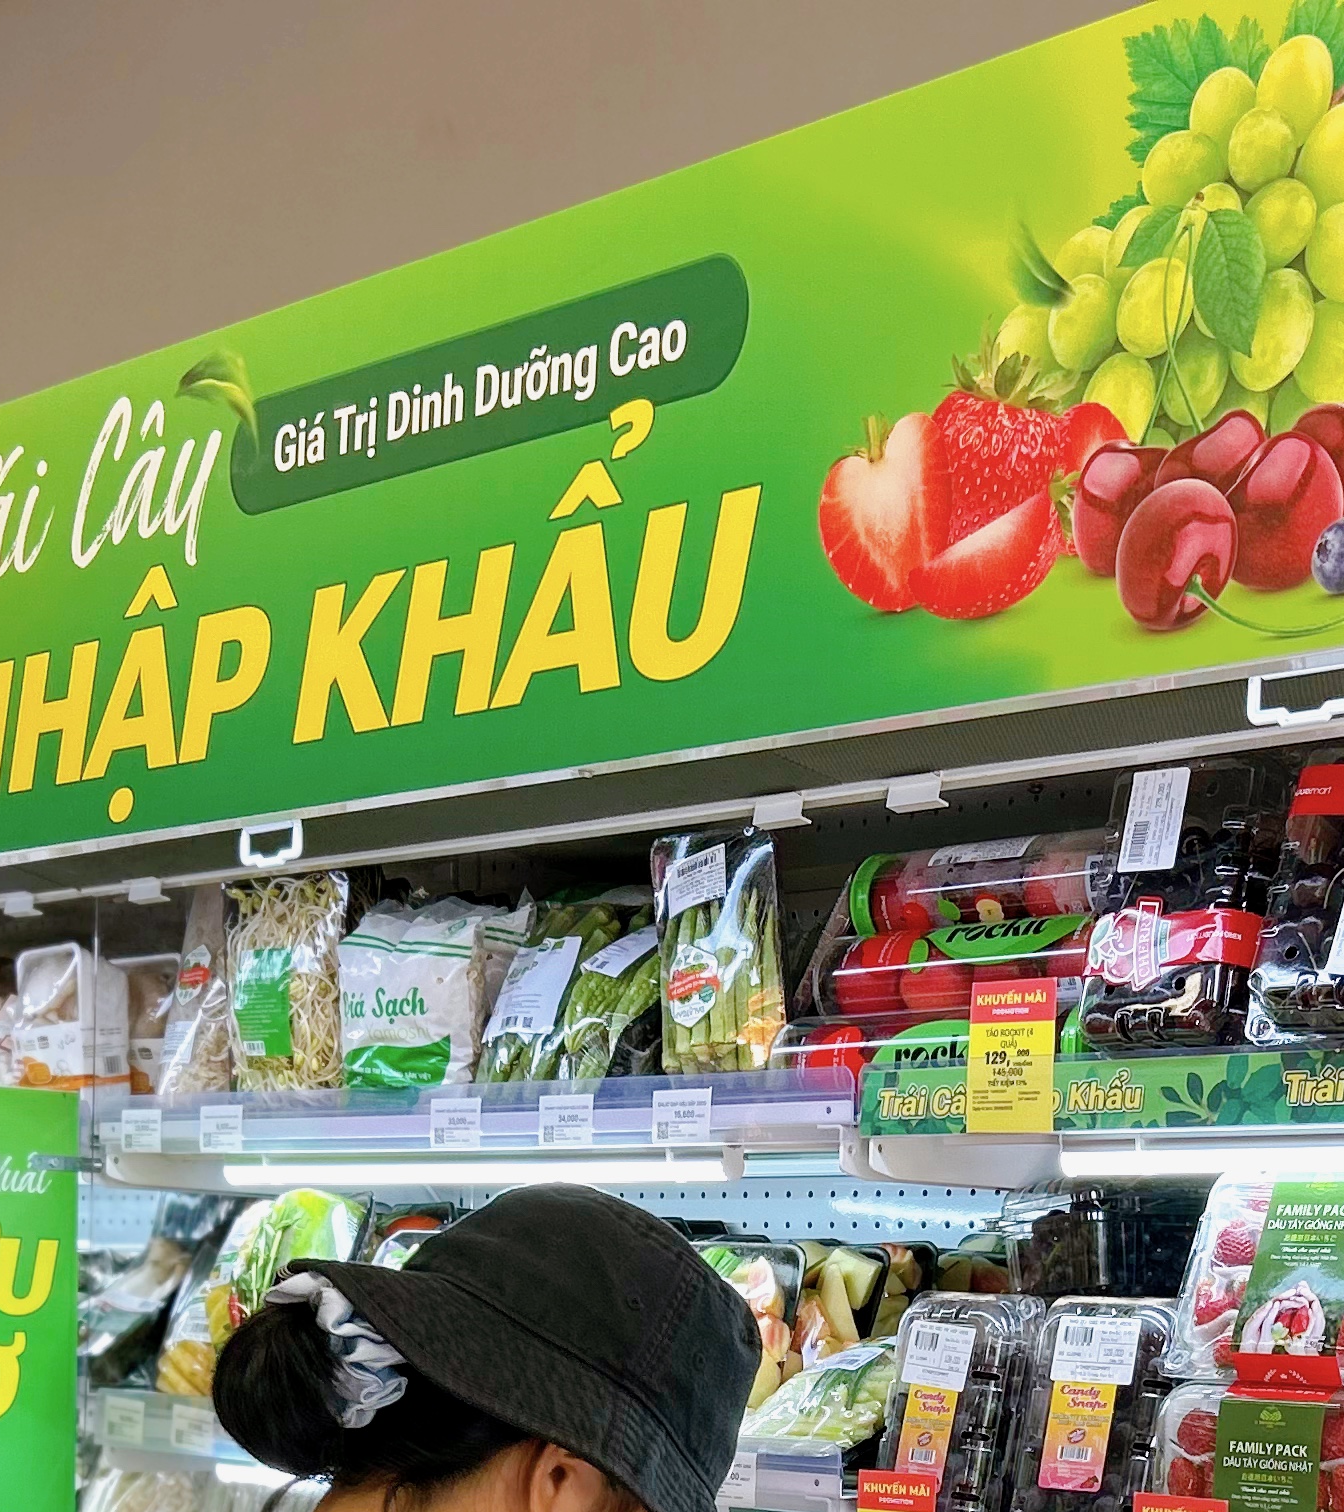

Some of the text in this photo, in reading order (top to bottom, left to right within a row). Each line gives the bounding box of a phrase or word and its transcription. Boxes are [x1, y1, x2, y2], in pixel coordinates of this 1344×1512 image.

[272, 320, 688, 473] Giá Trị Dinh Dưỡng Cao
[70, 395, 224, 569] Cây
[291, 398, 764, 747] KHẨU
[371, 987, 428, 1024] Sạch
[977, 990, 1046, 1006] KHUYẾN MÃI
[878, 1085, 927, 1118] Trái
[1066, 1067, 1146, 1114] Khẩu
[1276, 1205, 1322, 1216] FAMILY
[1060, 1384, 1101, 1399] Candy
[1067, 1396, 1108, 1411] Snaps
[1229, 1440, 1308, 1457] FAMILY PACK
[863, 1481, 931, 1496] KHUYẾN MÃI
